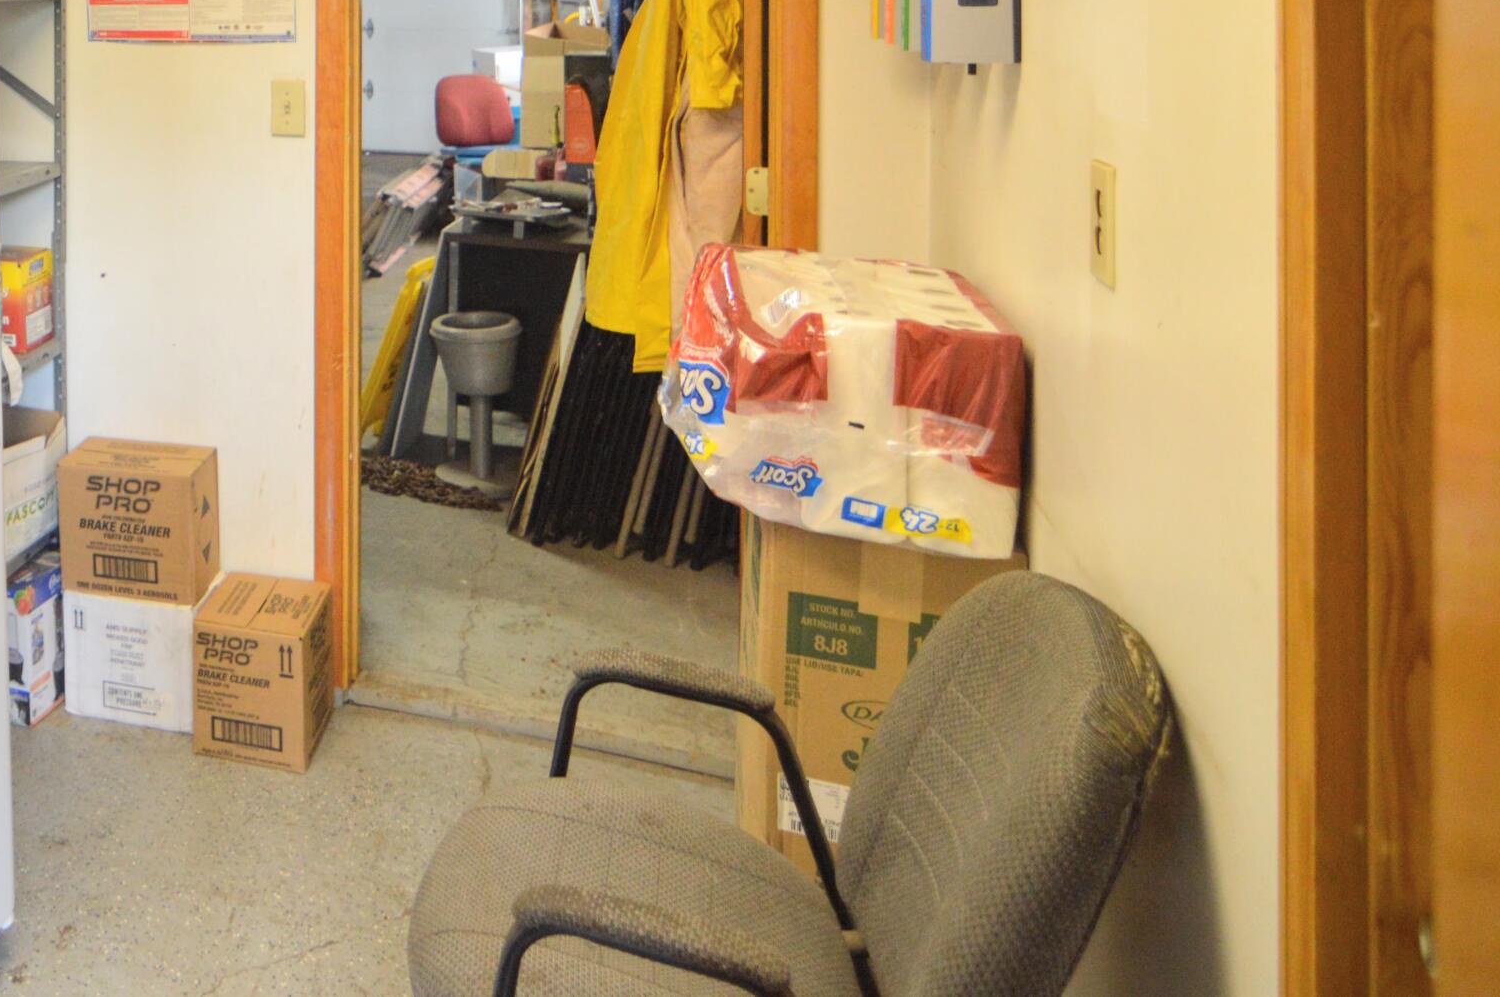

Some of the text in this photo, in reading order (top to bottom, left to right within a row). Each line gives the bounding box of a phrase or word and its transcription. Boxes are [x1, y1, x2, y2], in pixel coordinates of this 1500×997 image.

[85, 474, 162, 496] SHOP
[754, 466, 812, 494] Scott
[95, 493, 152, 514] PRO
[79, 517, 171, 539] BRAKE CLEANER
[900, 506, 939, 535] 24
[76, 580, 90, 589] ONE
[91, 582, 113, 592] DOZEN
[114, 585, 135, 596] LEVEL
[143, 589, 178, 601] AEROSOLS
[808, 602, 856, 619] STOCK NO.
[196, 632, 258, 651] SHOP
[814, 634, 848, 656] 8J8
[203, 647, 251, 666] PRO
[197, 668, 227, 683] BRAKE
[229, 672, 271, 689] CLEANER
